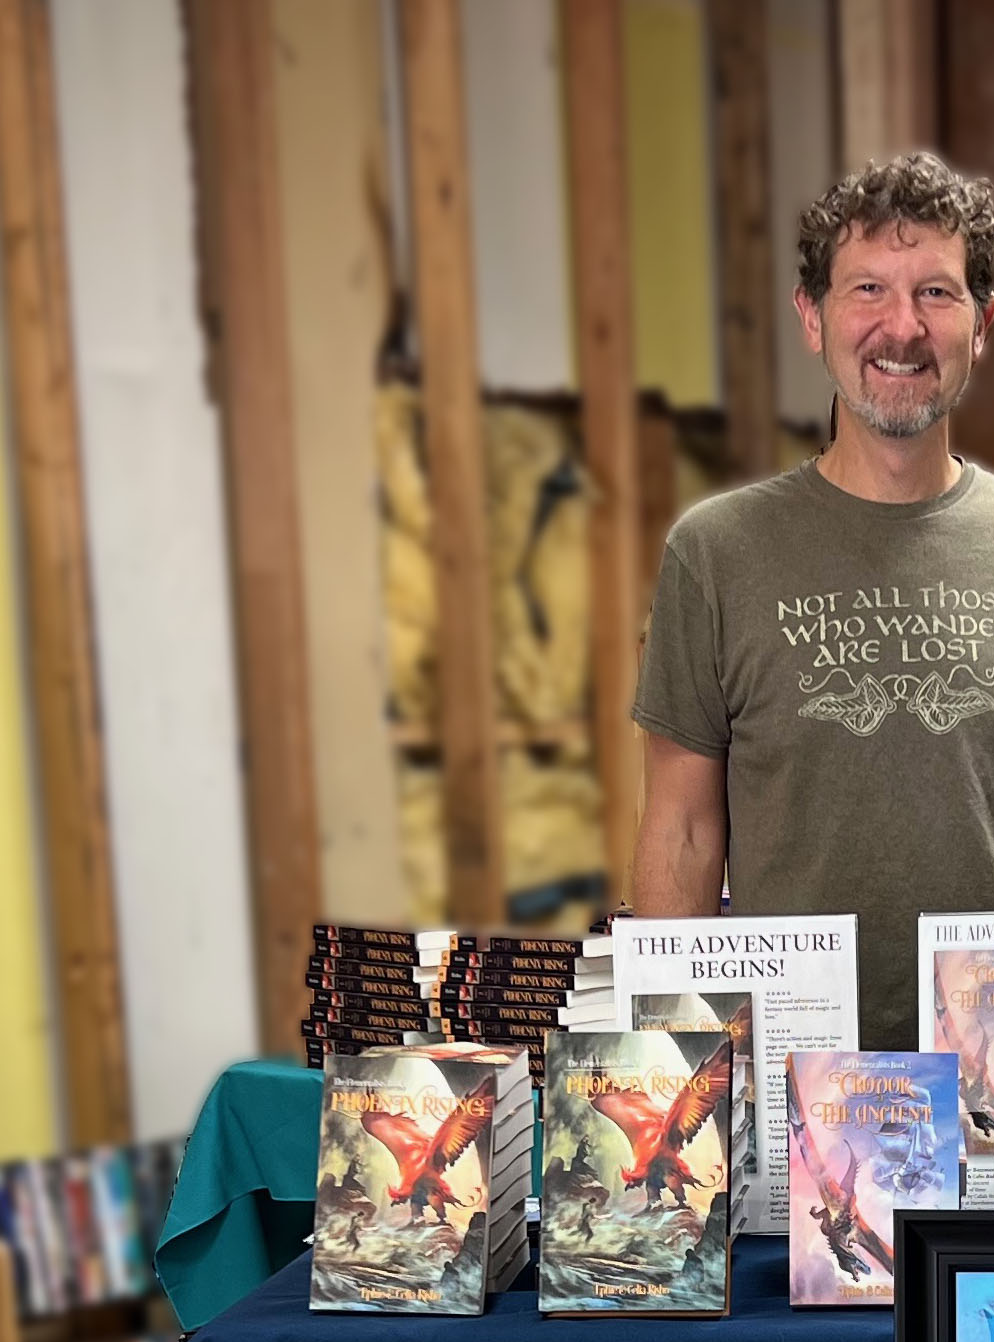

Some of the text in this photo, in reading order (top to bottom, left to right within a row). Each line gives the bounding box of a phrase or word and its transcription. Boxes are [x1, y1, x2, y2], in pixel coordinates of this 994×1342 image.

[778, 592, 842, 620] NOT
[853, 588, 911, 611] ALL
[813, 638, 986, 668] ARE LOST
[633, 933, 842, 956] THE ADVENTURE
[935, 925, 963, 942] THE
[691, 959, 785, 979] BEGINS!
[566, 1067, 711, 1100] PHOENIX RISING
[331, 1086, 487, 1119] PHOENIX RISING
